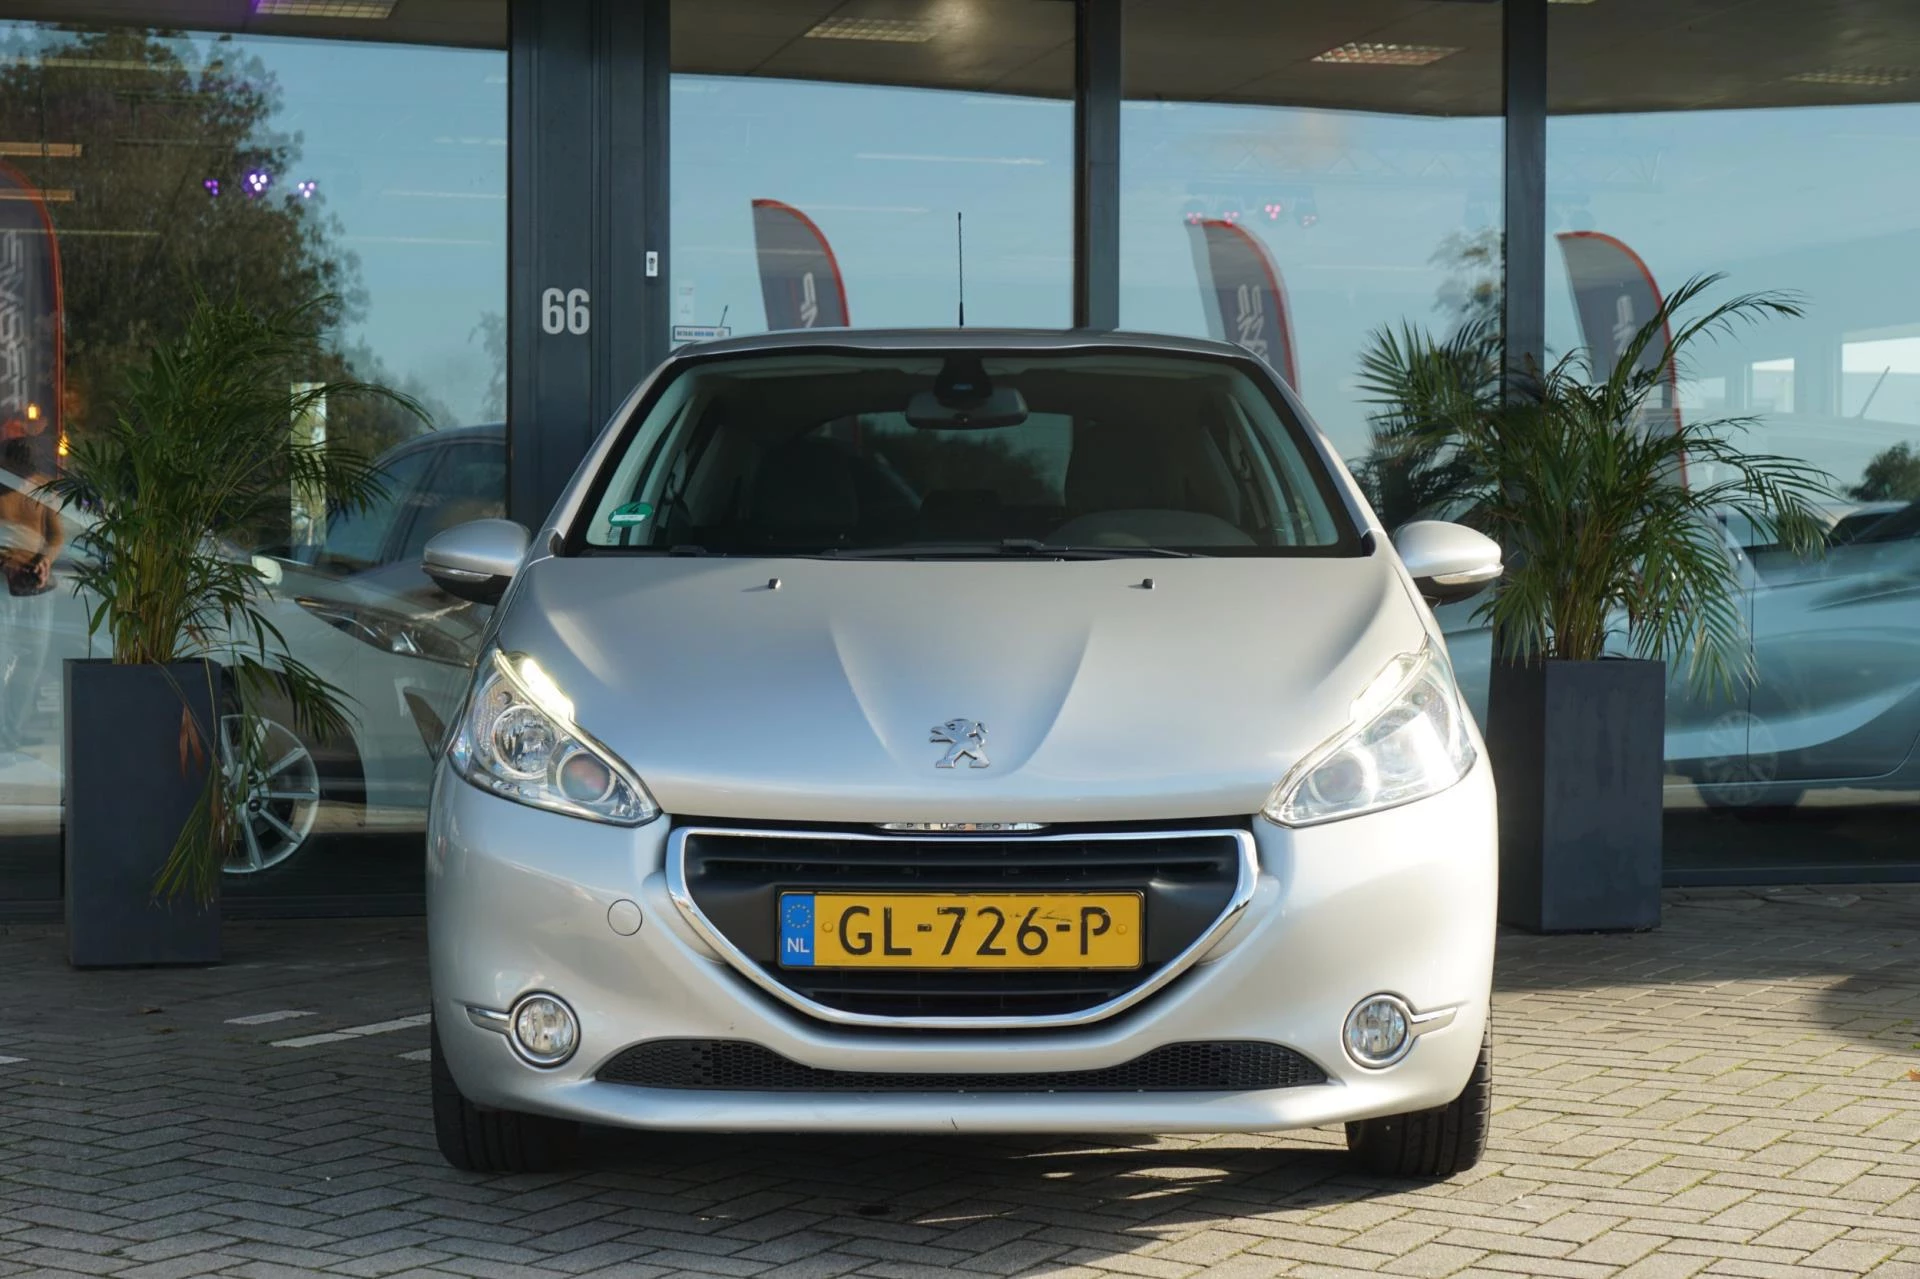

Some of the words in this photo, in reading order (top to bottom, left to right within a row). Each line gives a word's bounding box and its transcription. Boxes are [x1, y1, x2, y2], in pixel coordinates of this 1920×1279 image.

[542, 287, 590, 335] 66
[786, 937, 810, 953] NL
[838, 905, 1112, 956] GL-726-P
